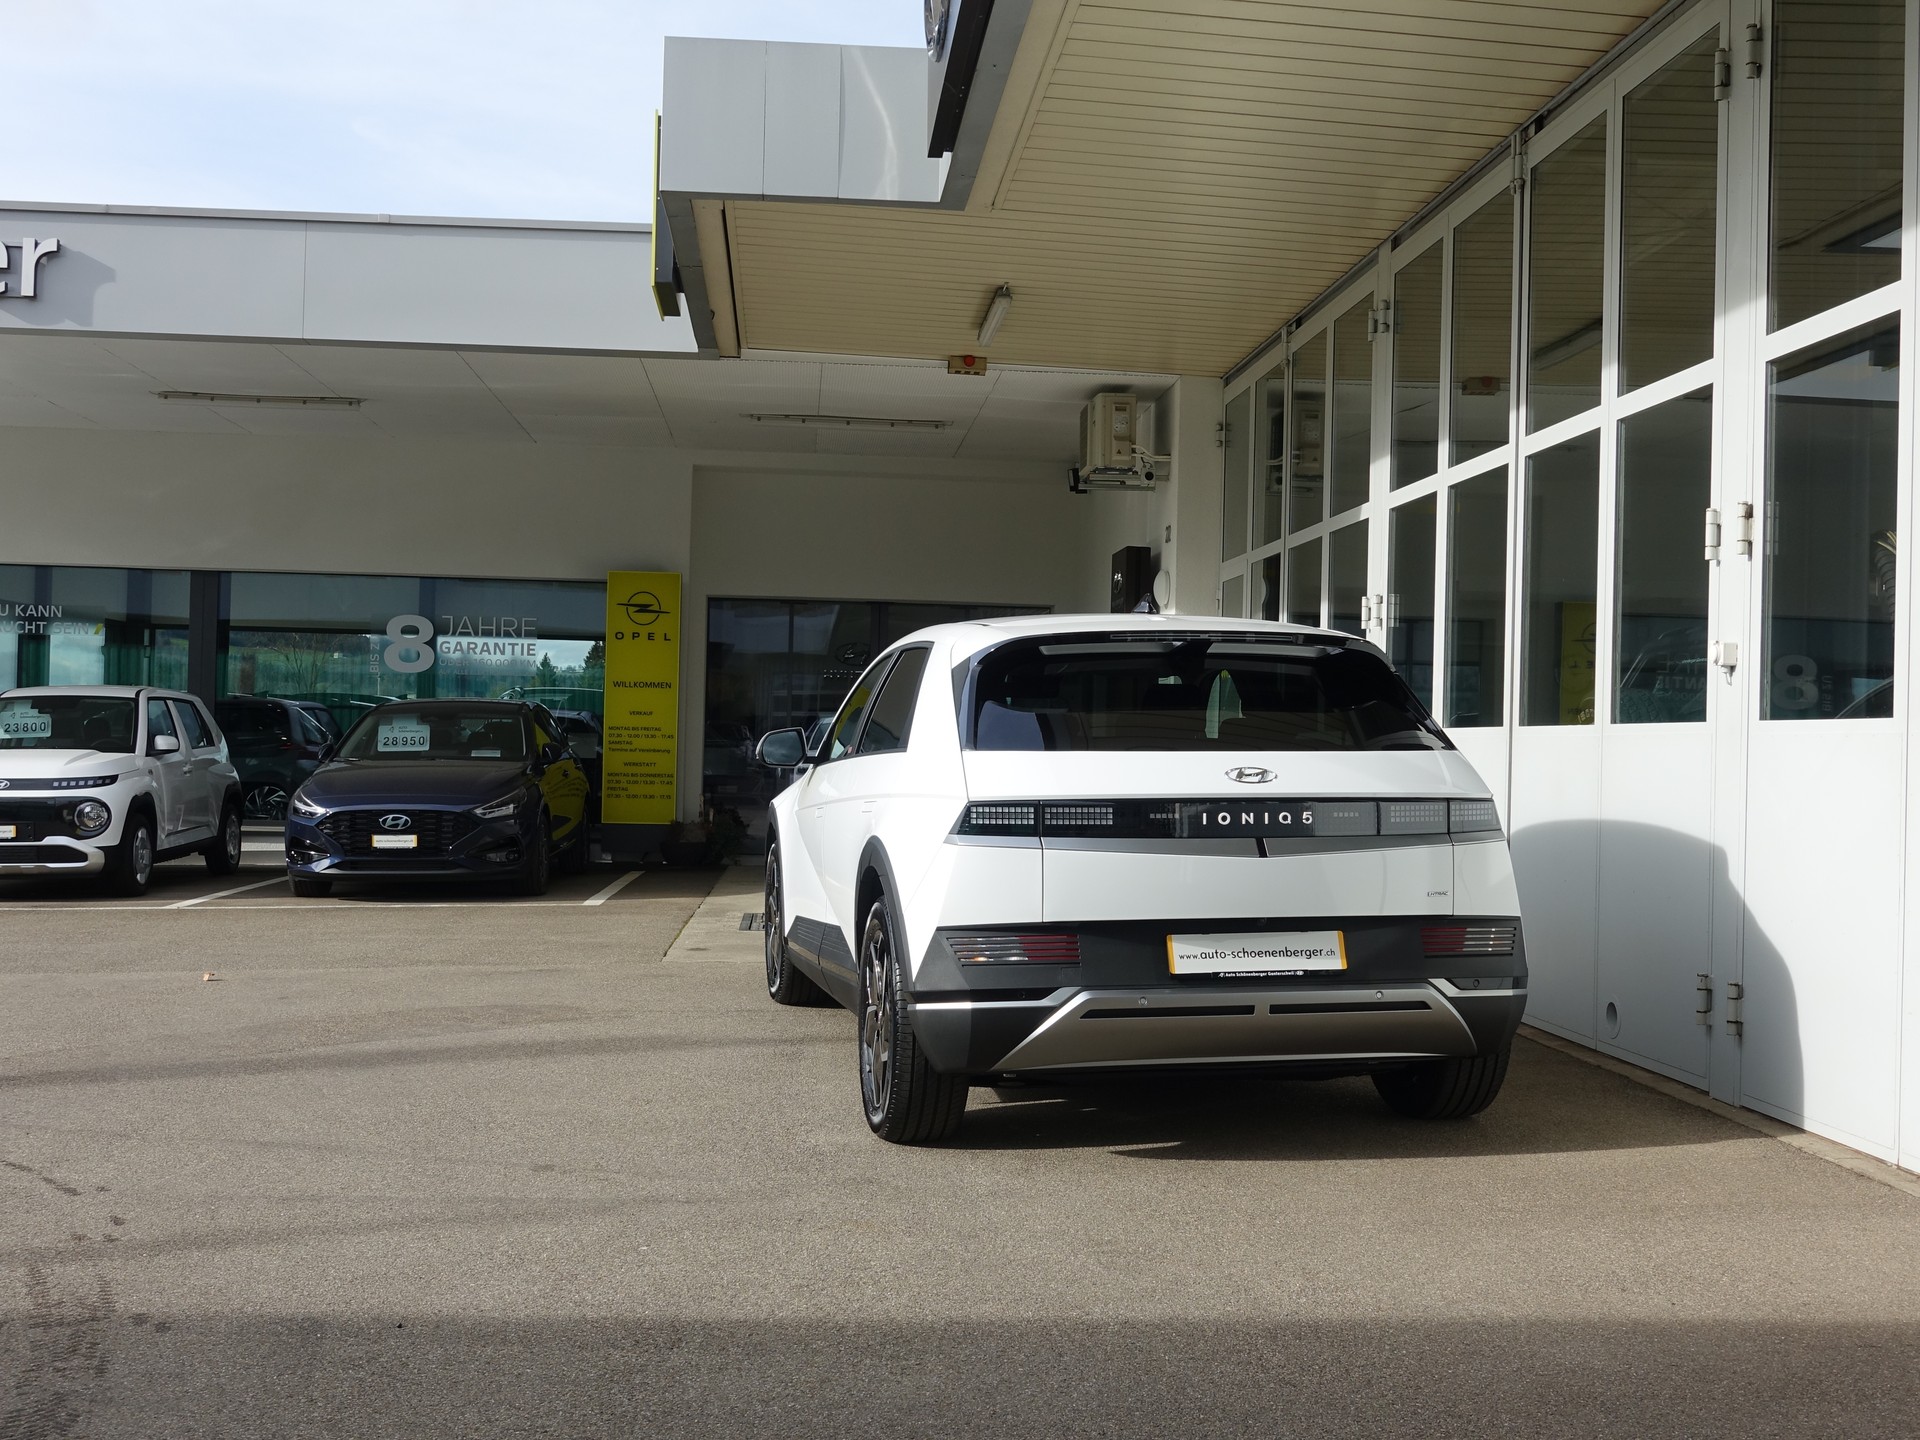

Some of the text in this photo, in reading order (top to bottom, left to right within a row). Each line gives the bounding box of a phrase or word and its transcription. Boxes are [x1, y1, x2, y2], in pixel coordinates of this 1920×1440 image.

[15, 604, 62, 618] KANN
[53, 622, 89, 635] SEIN
[614, 631, 672, 641] OPEL
[384, 614, 537, 673] 8 JAHRE
[439, 641, 537, 656] GARANTIE
[369, 654, 381, 673] BIS
[612, 680, 672, 689] WILLKOMMEN
[4, 722, 46, 733] 23800
[383, 736, 425, 746] 28950
[1201, 811, 1314, 826] IONIQ 5
[1177, 946, 1336, 962] www.auto-schoenenberger.ch
